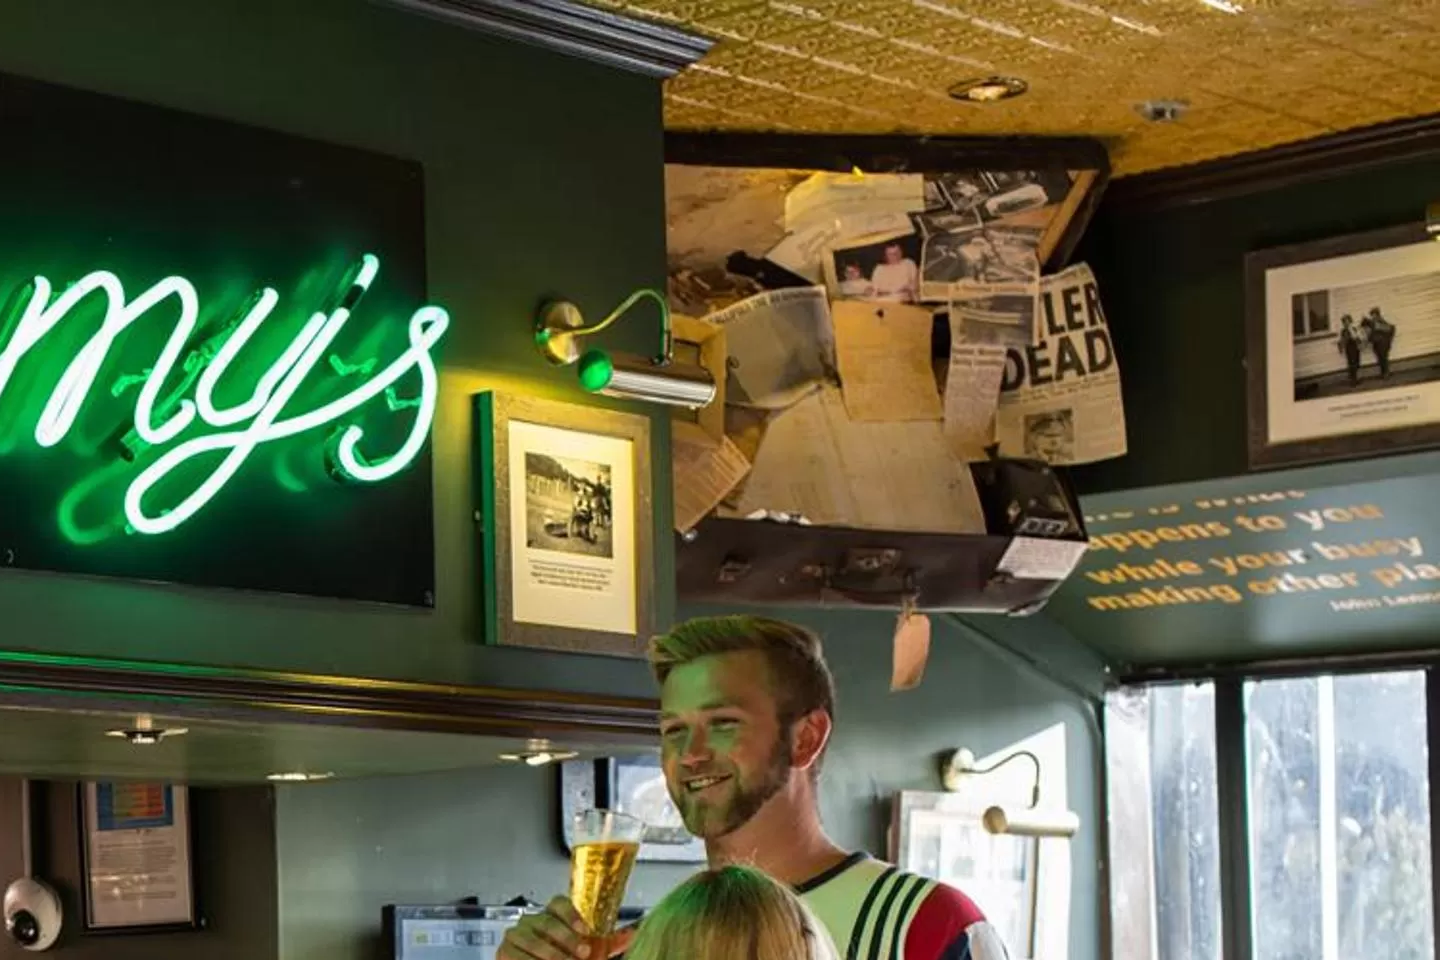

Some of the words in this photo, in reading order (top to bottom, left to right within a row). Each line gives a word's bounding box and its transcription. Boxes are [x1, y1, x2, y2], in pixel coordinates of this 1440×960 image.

[1043, 282, 1106, 336] LER
[1000, 329, 1114, 393] DEAD
[1088, 521, 1231, 552] appens
[1234, 515, 1287, 532] to
[1293, 504, 1384, 531] you
[1085, 558, 1204, 584] while
[1311, 536, 1423, 561] busy
[1087, 584, 1242, 611] making
[1247, 571, 1358, 595] other
